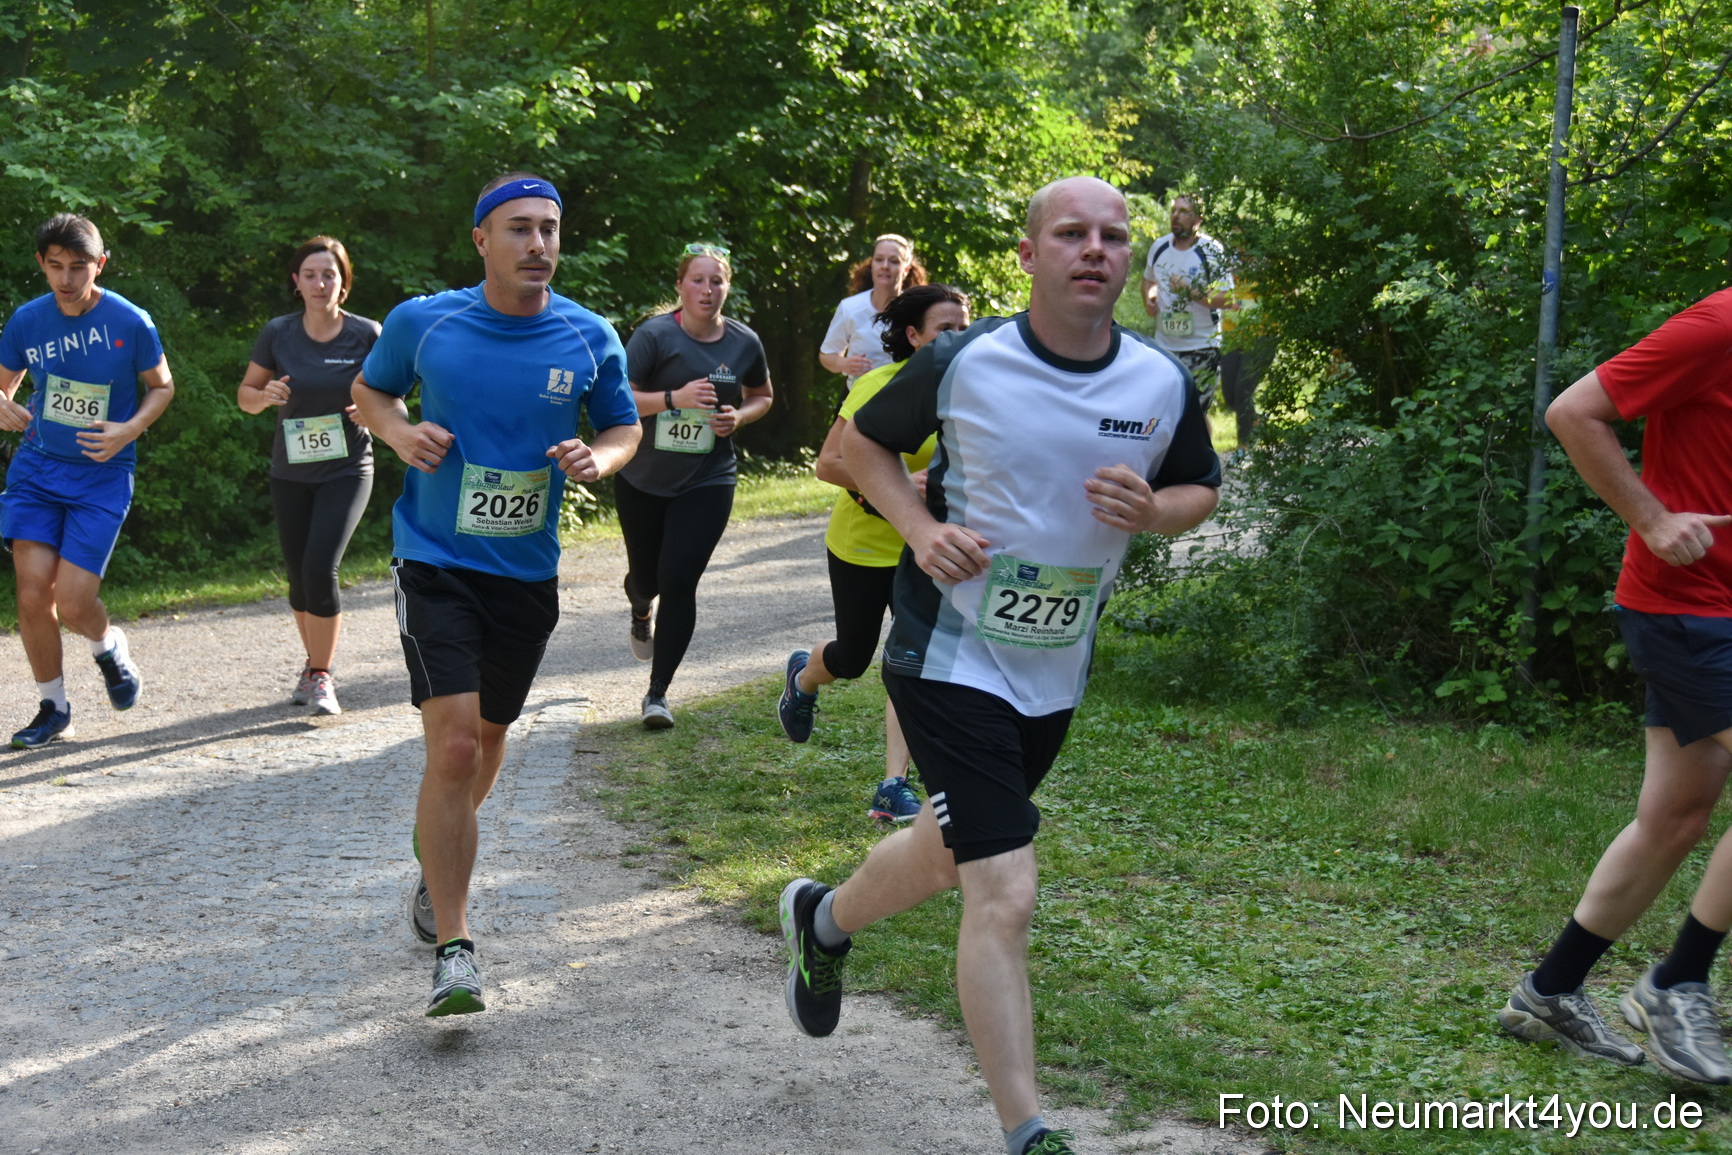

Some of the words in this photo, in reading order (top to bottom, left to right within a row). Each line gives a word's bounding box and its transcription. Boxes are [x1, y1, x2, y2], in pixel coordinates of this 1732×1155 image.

[1164, 321, 1189, 330] 1875
[51, 393, 99, 416] 2036
[668, 423, 703, 440] 407
[1098, 418, 1143, 434] swn
[297, 432, 331, 450] 156
[469, 491, 540, 519] 2026
[476, 517, 512, 525] Sebastian
[514, 517, 533, 525] Weiss
[1006, 574, 1054, 590] firmenlauf
[994, 589, 1080, 626] 2279
[1004, 621, 1028, 633] Marzi
[1030, 626, 1066, 635] Reinhard
